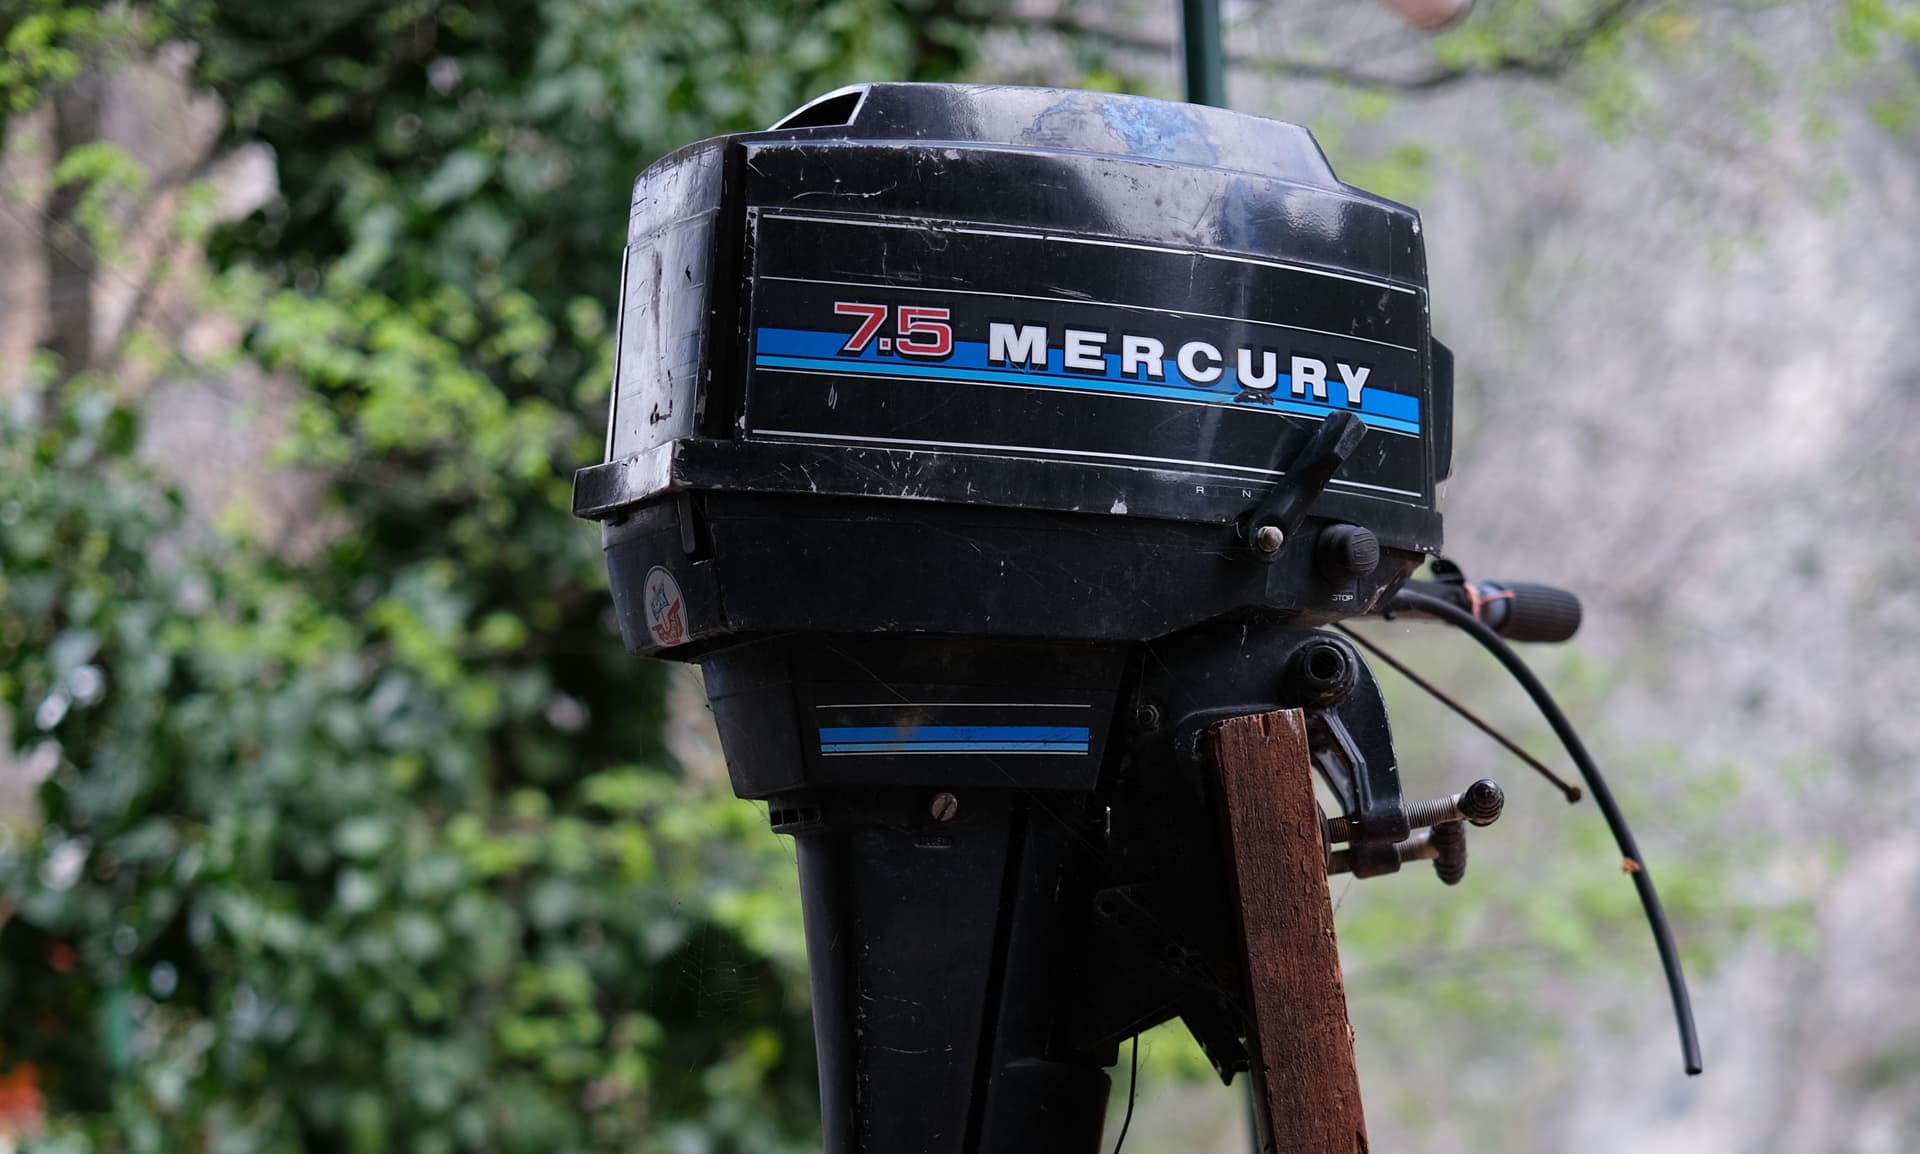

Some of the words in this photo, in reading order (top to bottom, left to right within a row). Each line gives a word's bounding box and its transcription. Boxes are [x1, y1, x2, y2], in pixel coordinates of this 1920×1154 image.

[833, 300, 953, 358] 7.5
[988, 321, 1371, 405] MERCURY
[1195, 485, 1205, 495] R
[1242, 489, 1252, 498] N
